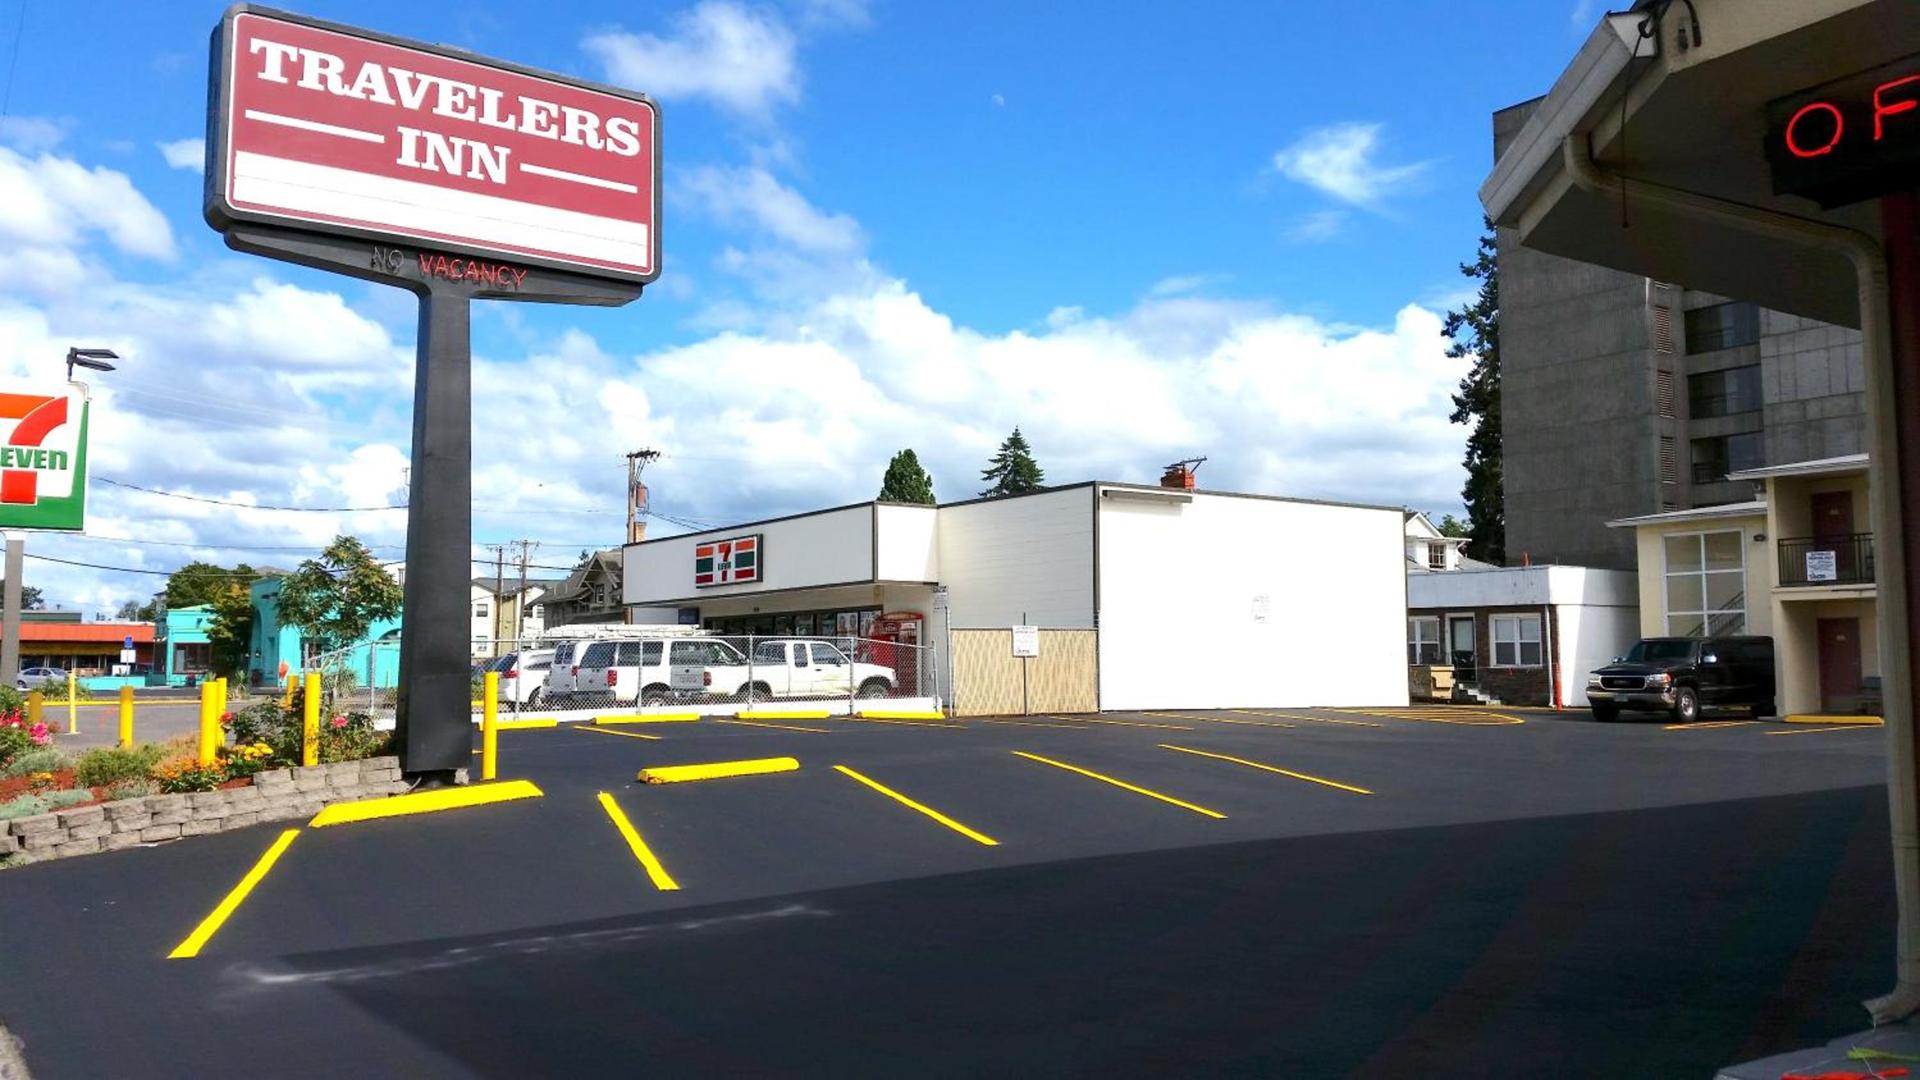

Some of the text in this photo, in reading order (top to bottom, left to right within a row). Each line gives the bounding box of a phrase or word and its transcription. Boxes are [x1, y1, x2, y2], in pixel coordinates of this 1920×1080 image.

[249, 37, 641, 157] TRAVELERS
[1785, 73, 1920, 158] OF
[396, 125, 511, 185] INN
[372, 246, 528, 288] NO VACANCY
[718, 542, 732, 582] 7
